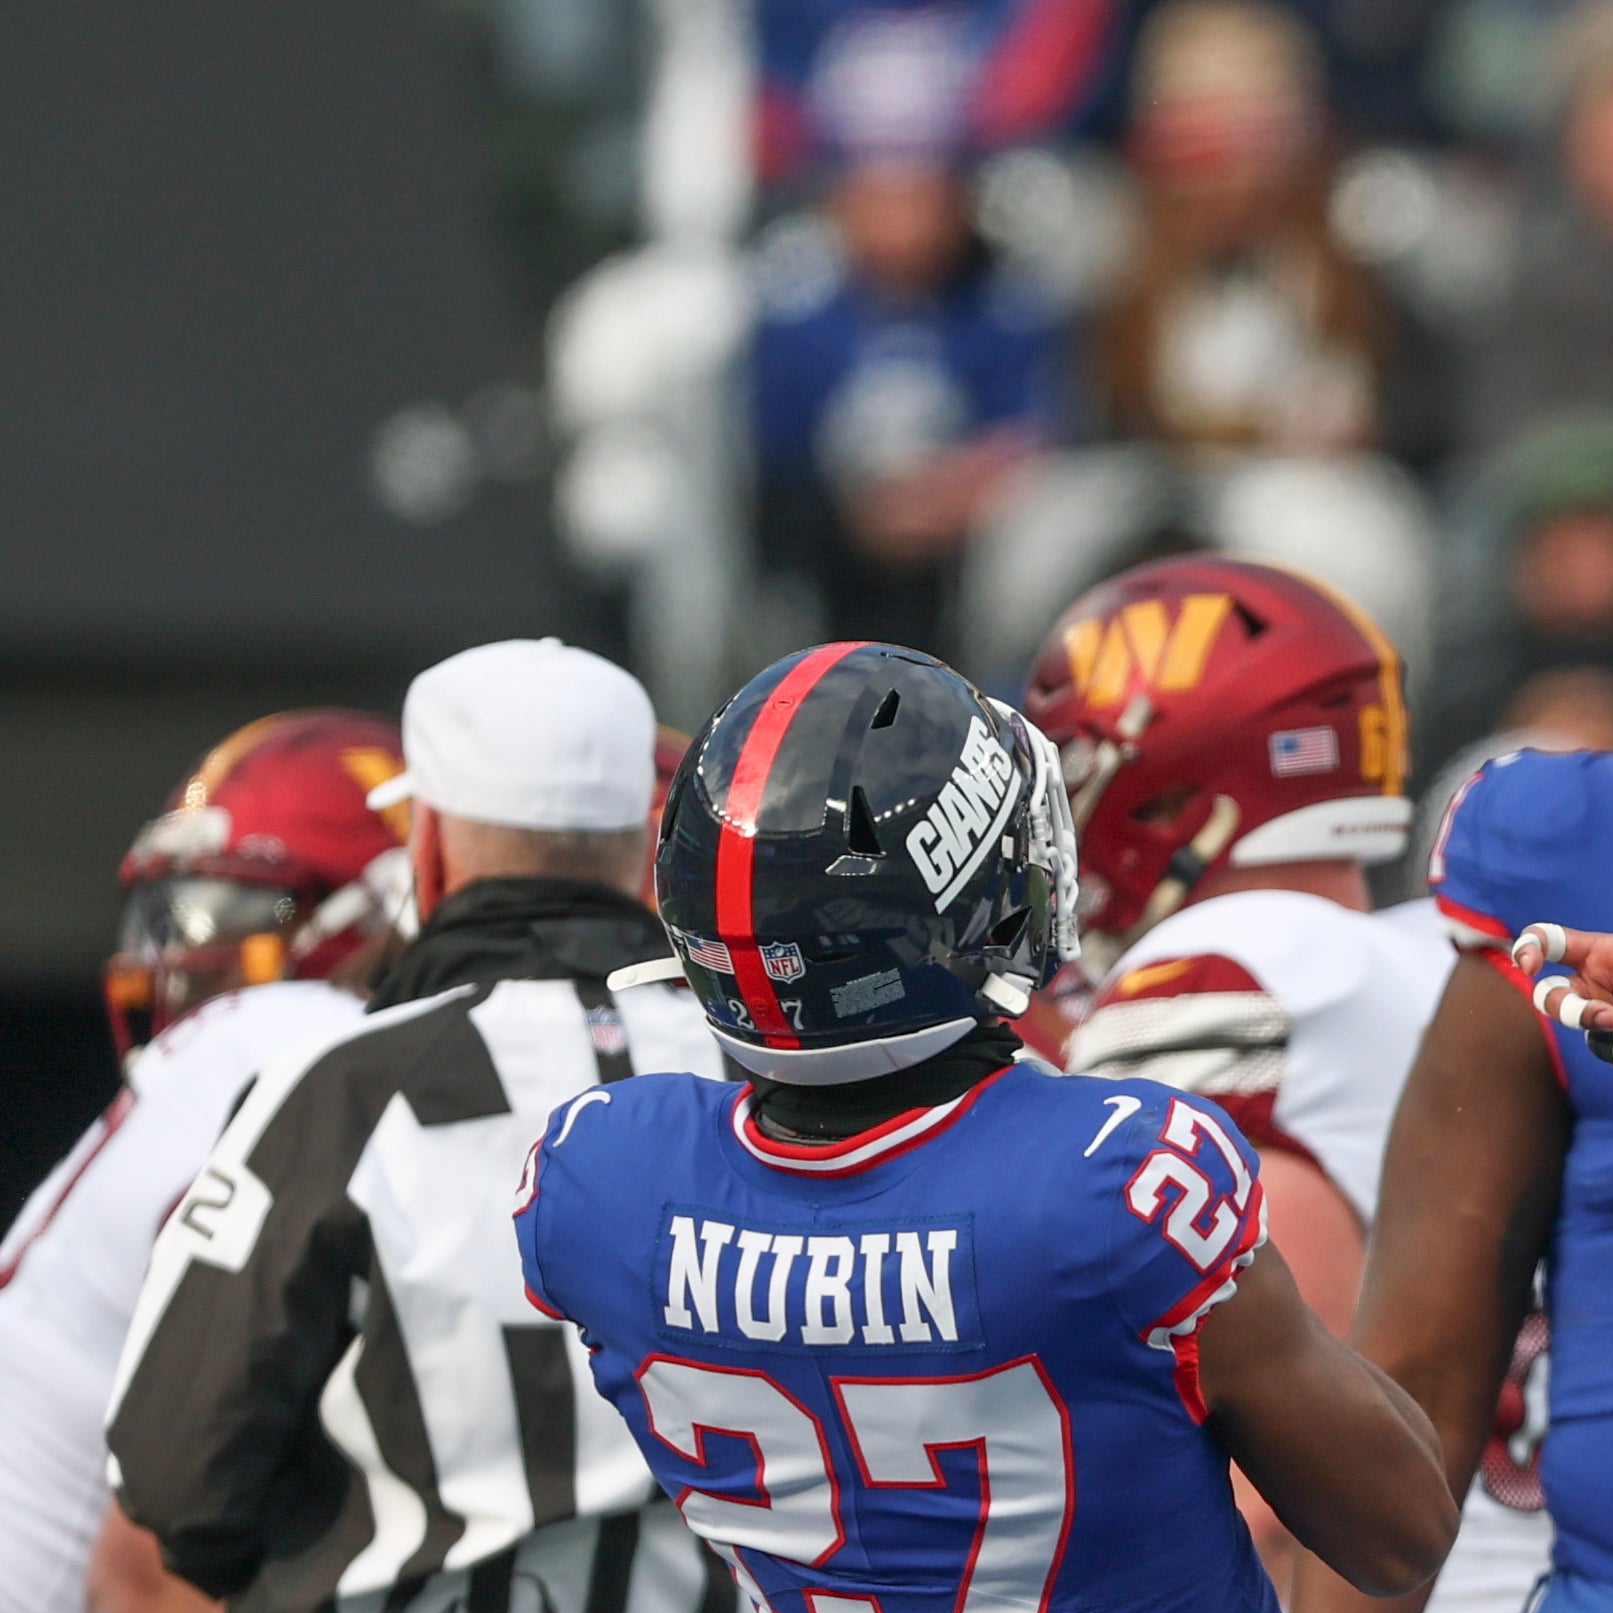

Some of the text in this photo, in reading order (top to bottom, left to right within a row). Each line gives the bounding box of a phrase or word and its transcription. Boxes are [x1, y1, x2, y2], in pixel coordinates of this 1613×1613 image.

[906, 715, 1013, 895] GIANTS
[769, 957, 800, 976] NFL
[1123, 1096, 1253, 1275] 27
[663, 1216, 960, 1345] NUBIN
